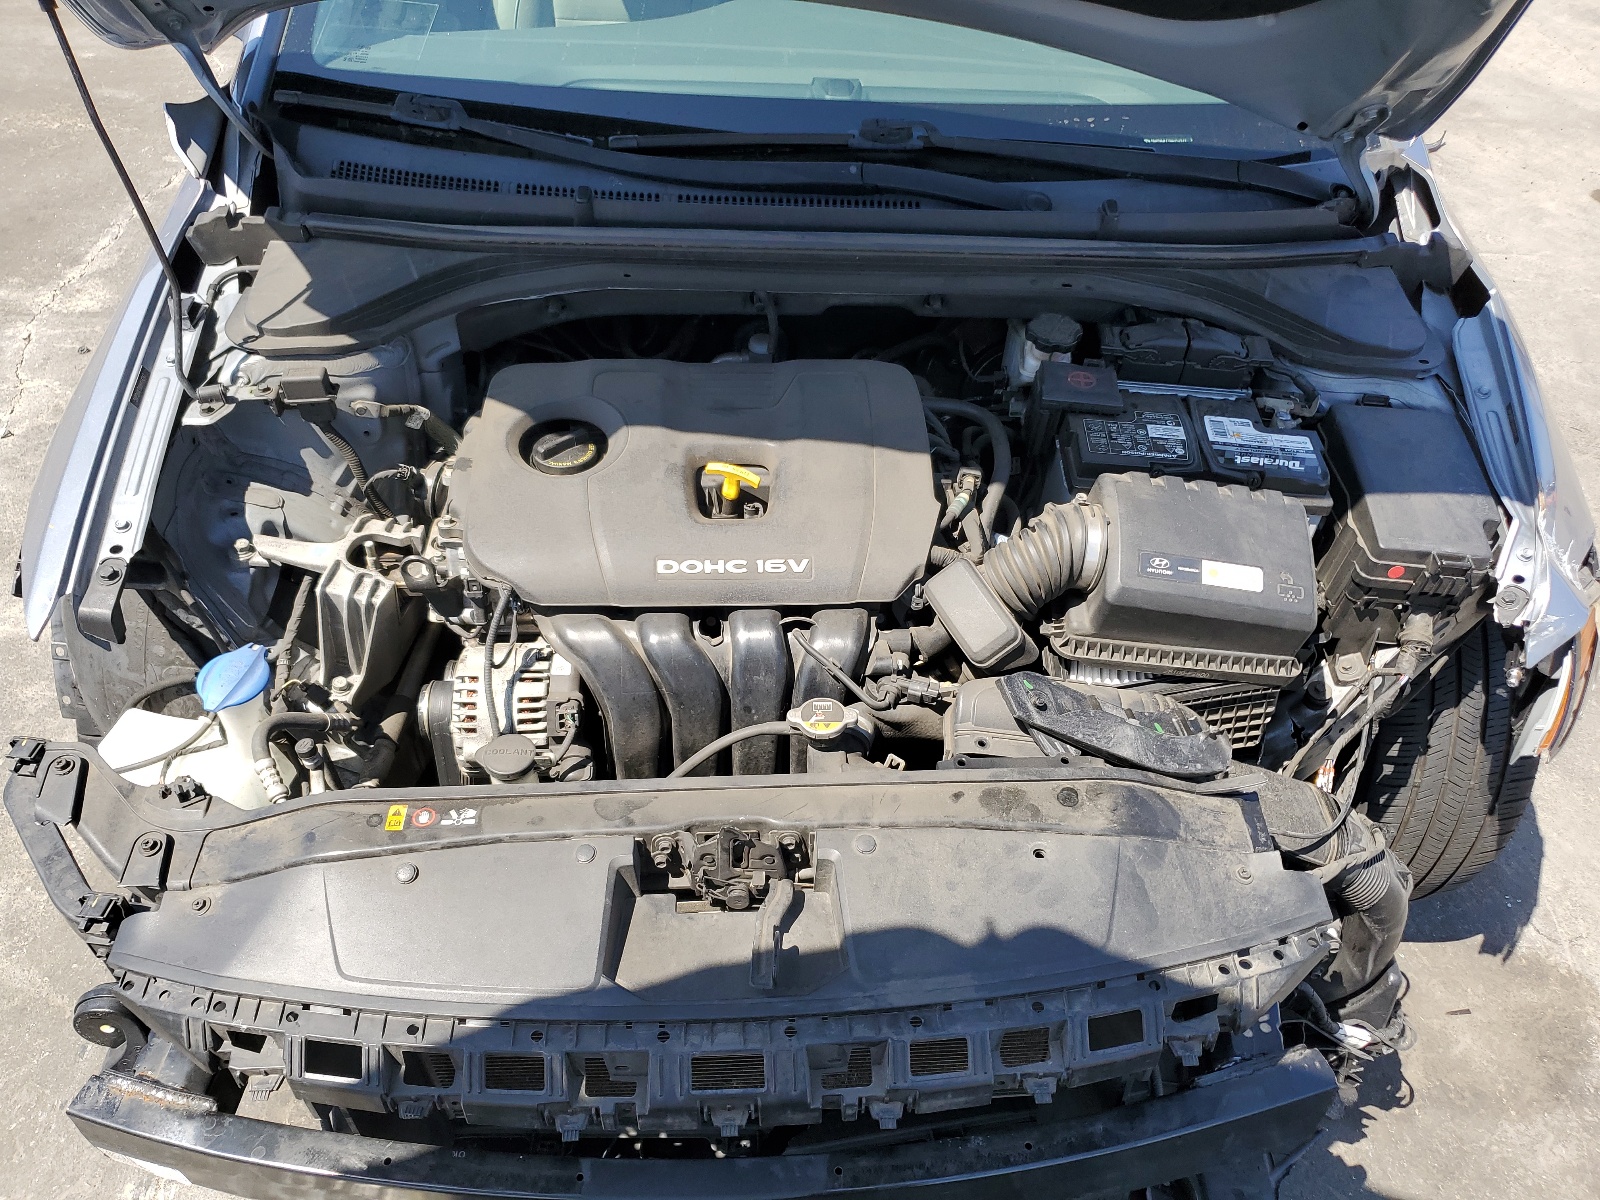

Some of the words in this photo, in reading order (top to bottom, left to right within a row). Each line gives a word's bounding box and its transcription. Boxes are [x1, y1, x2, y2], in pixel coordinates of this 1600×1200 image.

[1234, 455, 1305, 471] Duralast
[656, 559, 748, 574] DOHC
[755, 558, 810, 574] 16V
[1146, 567, 1174, 576] HYUNDAI
[485, 748, 535, 757] COOLANT
